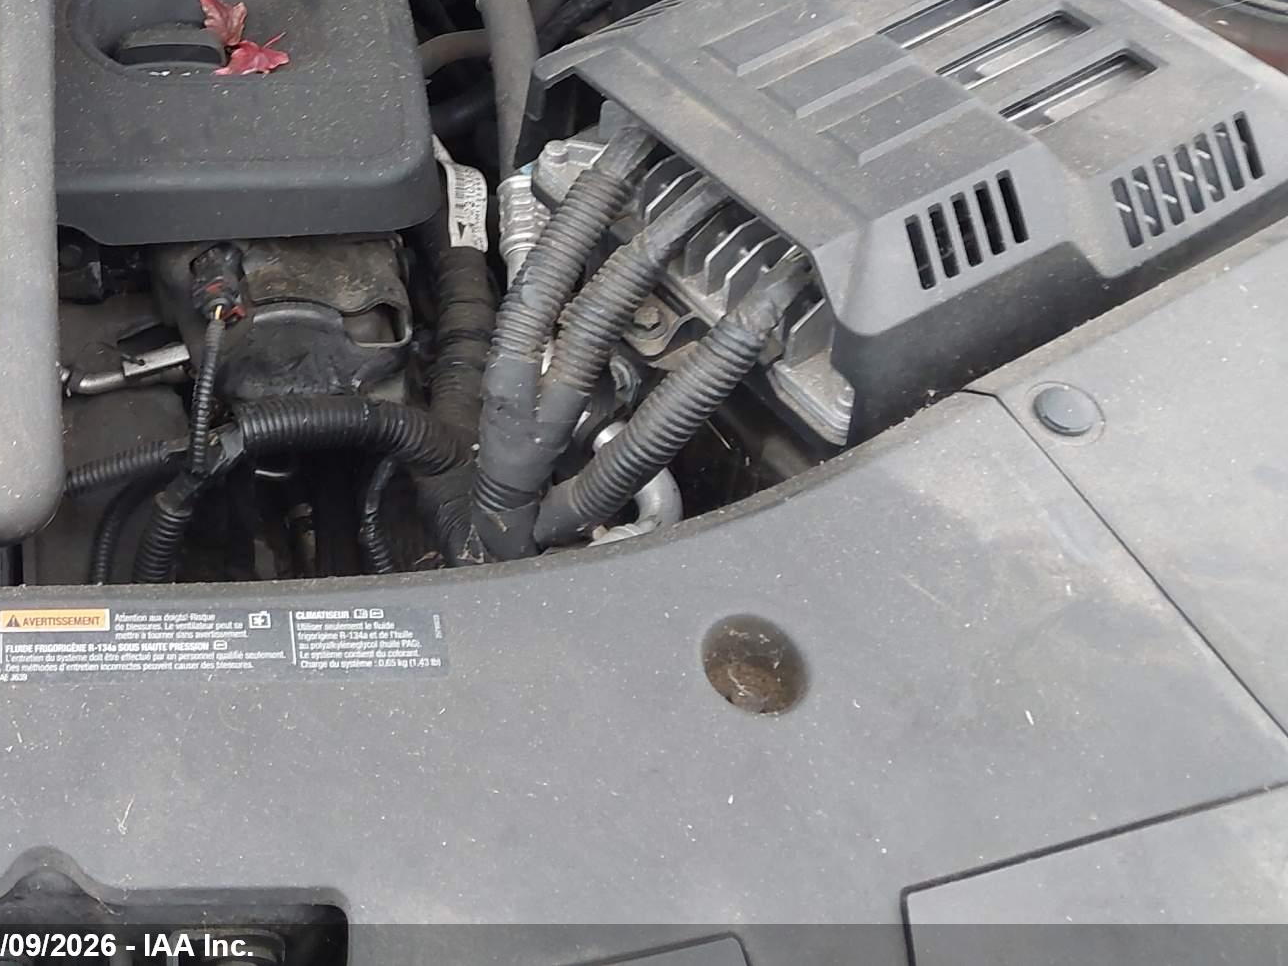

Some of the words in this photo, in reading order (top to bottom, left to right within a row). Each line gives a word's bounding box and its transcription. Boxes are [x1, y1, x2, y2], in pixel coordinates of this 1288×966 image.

[296, 610, 349, 619] CLIMATISEUR
[22, 616, 100, 626] AVERTISSEMENT
[5, 644, 33, 653] FLUIDE
[88, 643, 117, 652] R-134a
[118, 643, 140, 651] SOUS
[141, 642, 168, 651] HAUTE
[169, 642, 209, 651] PRESSION
